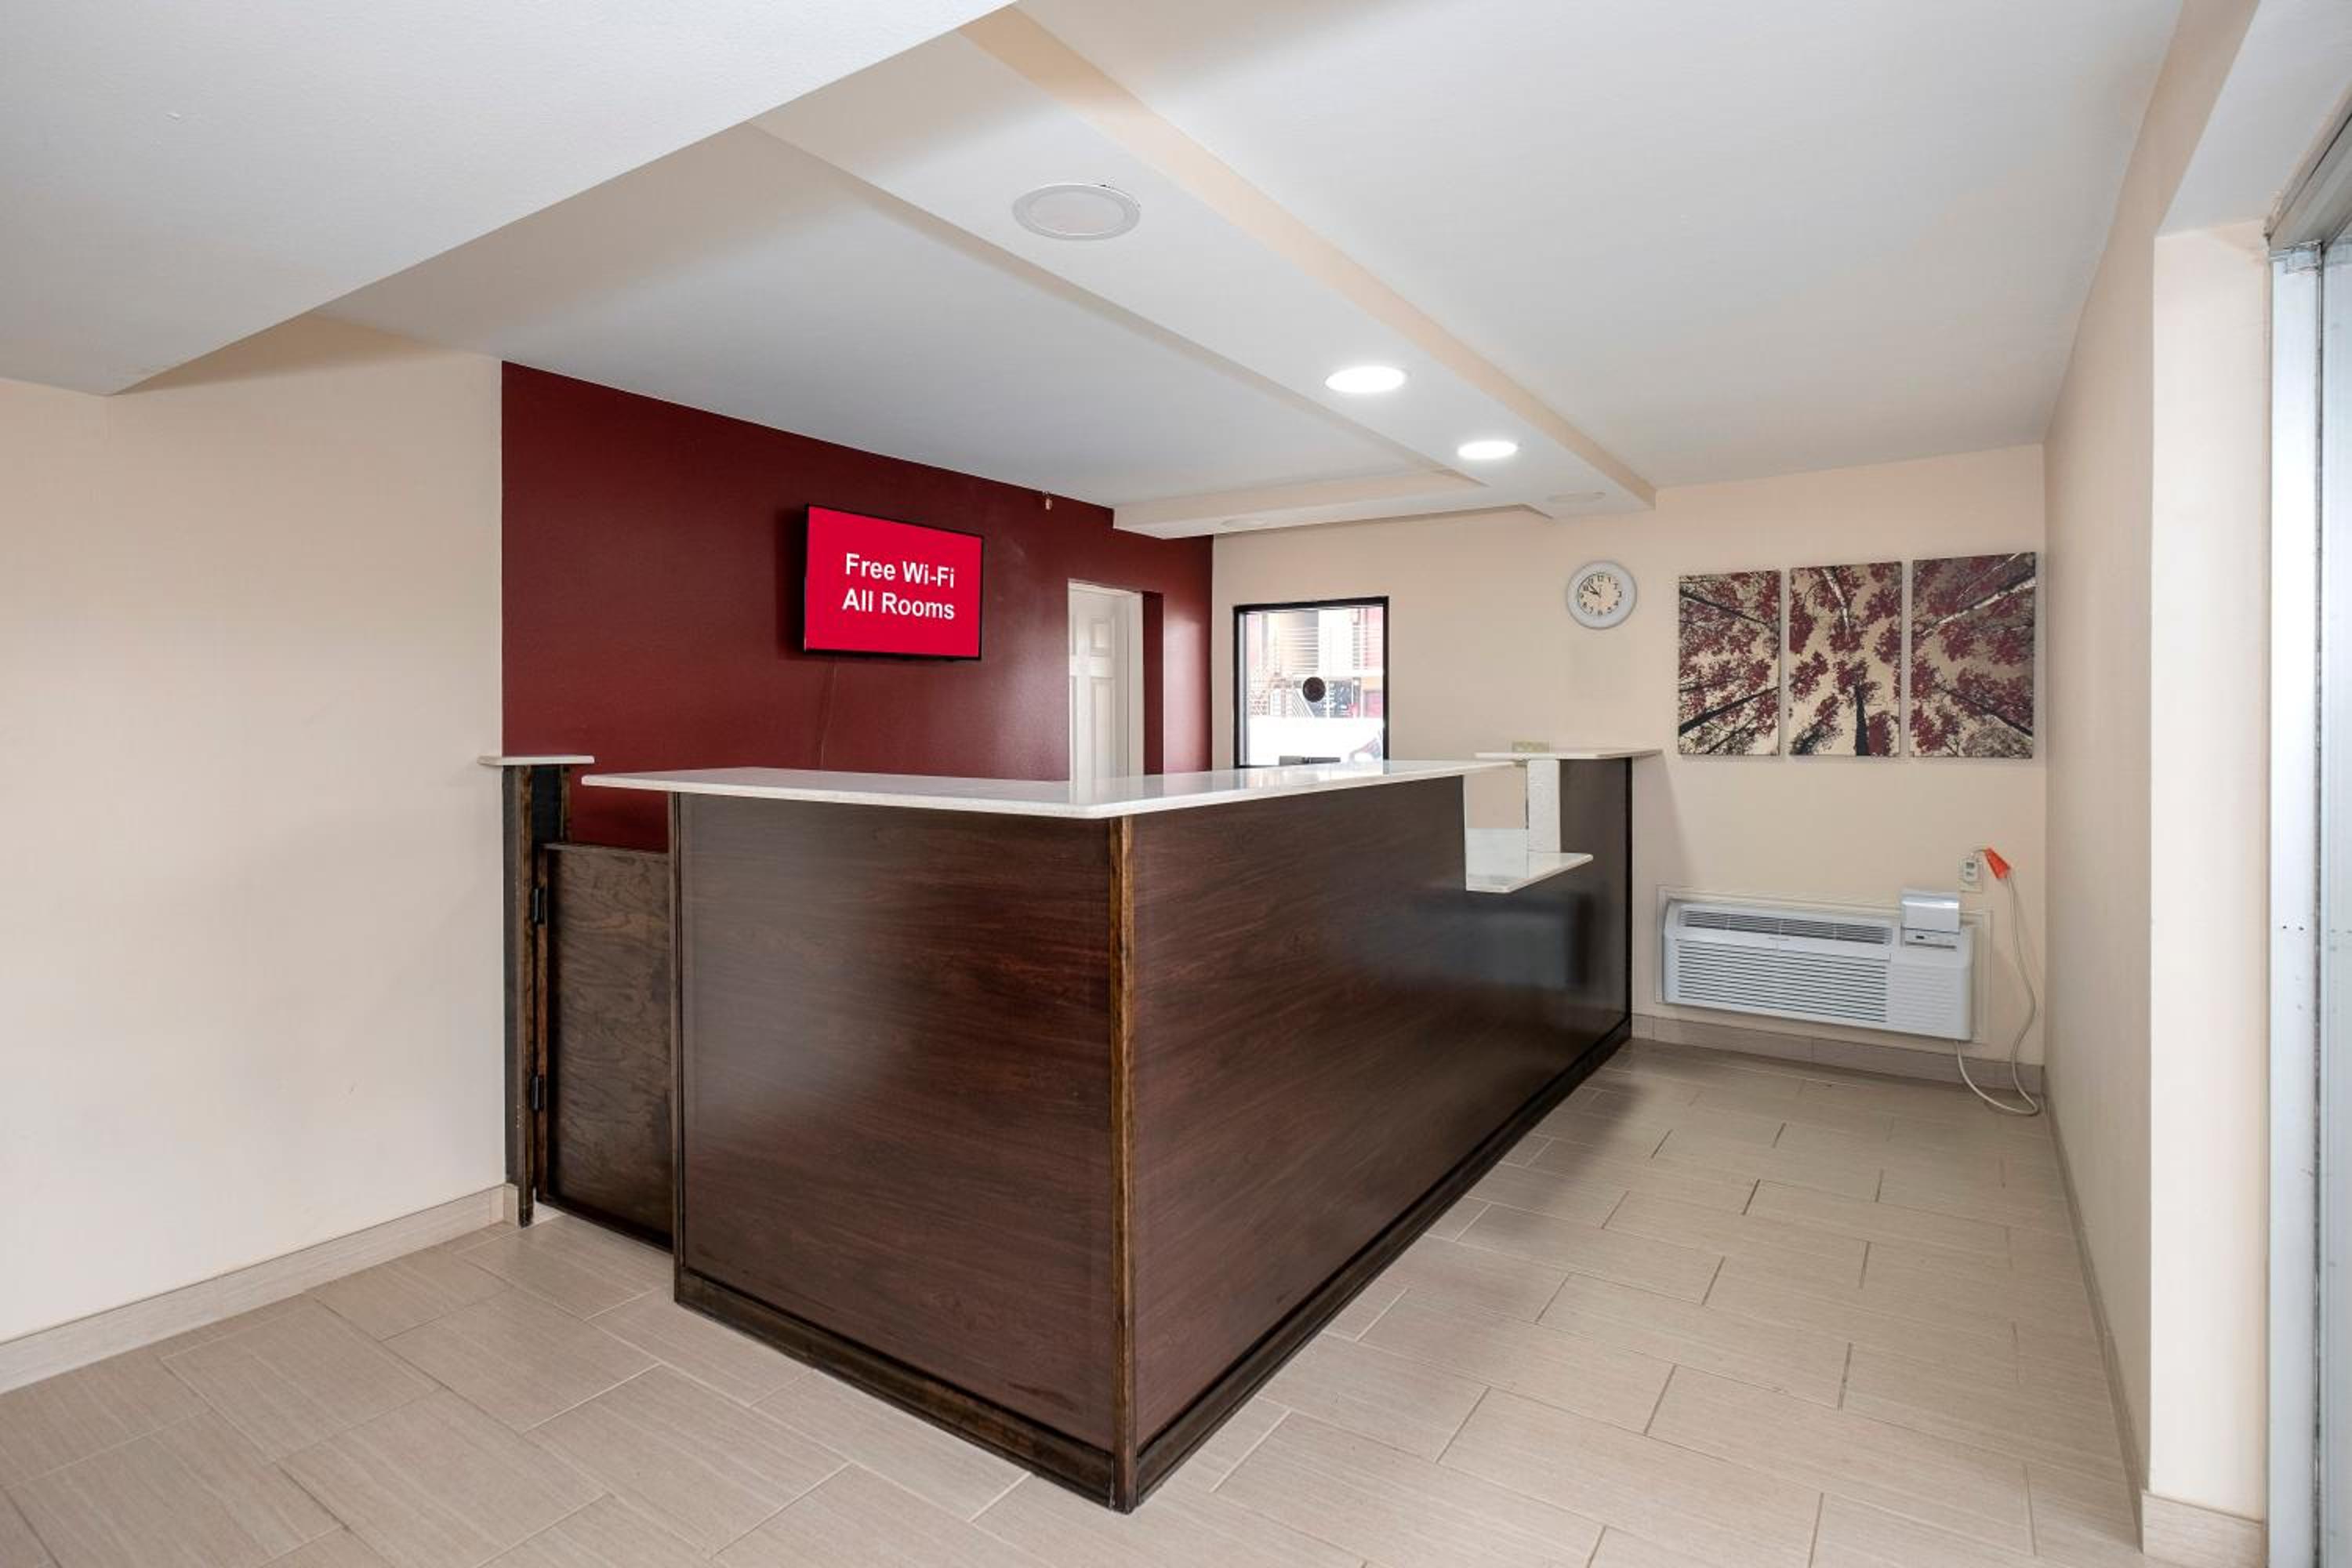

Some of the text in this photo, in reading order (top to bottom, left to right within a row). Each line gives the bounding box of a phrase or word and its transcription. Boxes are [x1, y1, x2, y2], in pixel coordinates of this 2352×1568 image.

[845, 552, 955, 588] Free Wi-Fi
[842, 588, 956, 620] All Rooms
